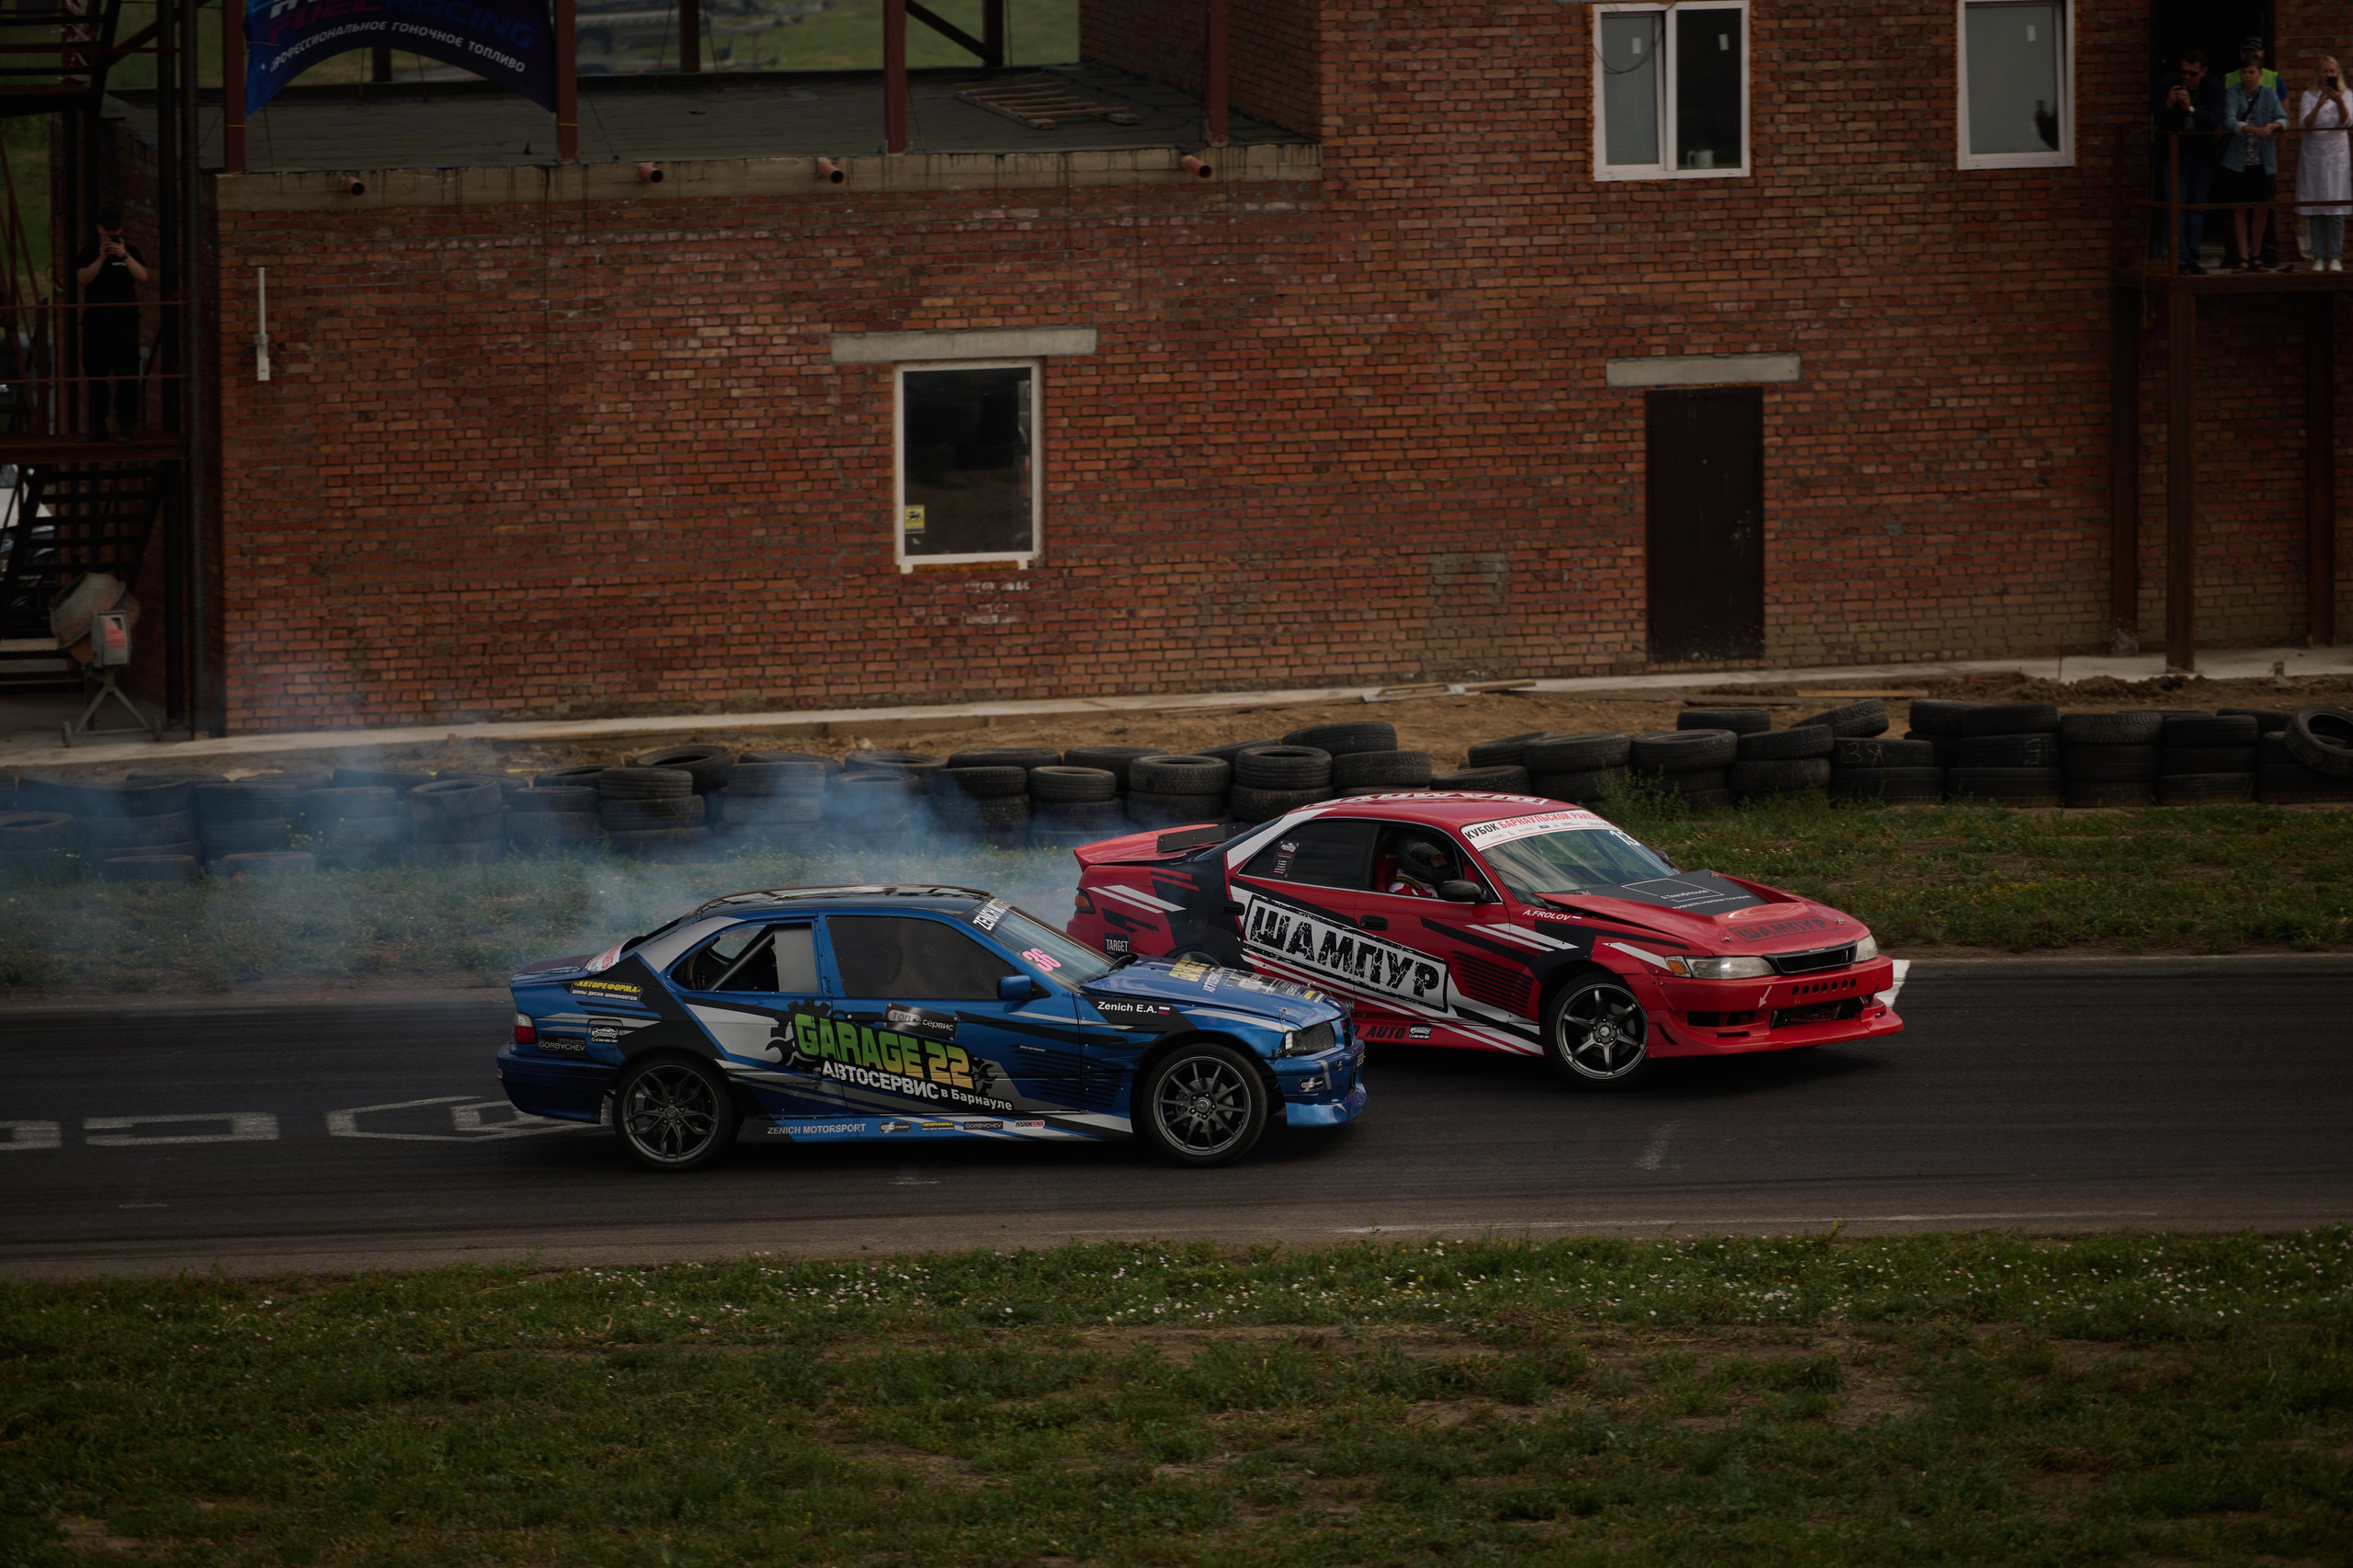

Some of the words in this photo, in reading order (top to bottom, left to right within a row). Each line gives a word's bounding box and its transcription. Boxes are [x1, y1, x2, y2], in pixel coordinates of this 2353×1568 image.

[392, 22, 464, 47] ГОНОЧНОЕ
[468, 40, 526, 73] ТОПЛИВО
[1464, 823, 1500, 840] КУБОК
[1497, 812, 1571, 829] БАРНАУЛЬСКОЙ
[1523, 909, 1572, 920] A.FROLOV
[1735, 919, 1826, 938] ШАМПУР
[1106, 938, 1129, 952] TARGET
[1250, 905, 1439, 998] ШАМПУР
[1022, 948, 1062, 971] 36
[1097, 1002, 1133, 1012] Zenich
[1136, 1004, 1157, 1014] E.A.
[922, 1017, 954, 1031] сервис
[1365, 1025, 1406, 1040] AUTO
[795, 1013, 925, 1079] GARAGE
[924, 1040, 974, 1089] 22
[822, 1061, 940, 1099] АВТОСЕРВИС
[940, 1087, 949, 1098] в
[951, 1088, 1013, 1111] Барнауле
[767, 1126, 801, 1134] ZENICH
[802, 1123, 866, 1133] MOTORSPORT
